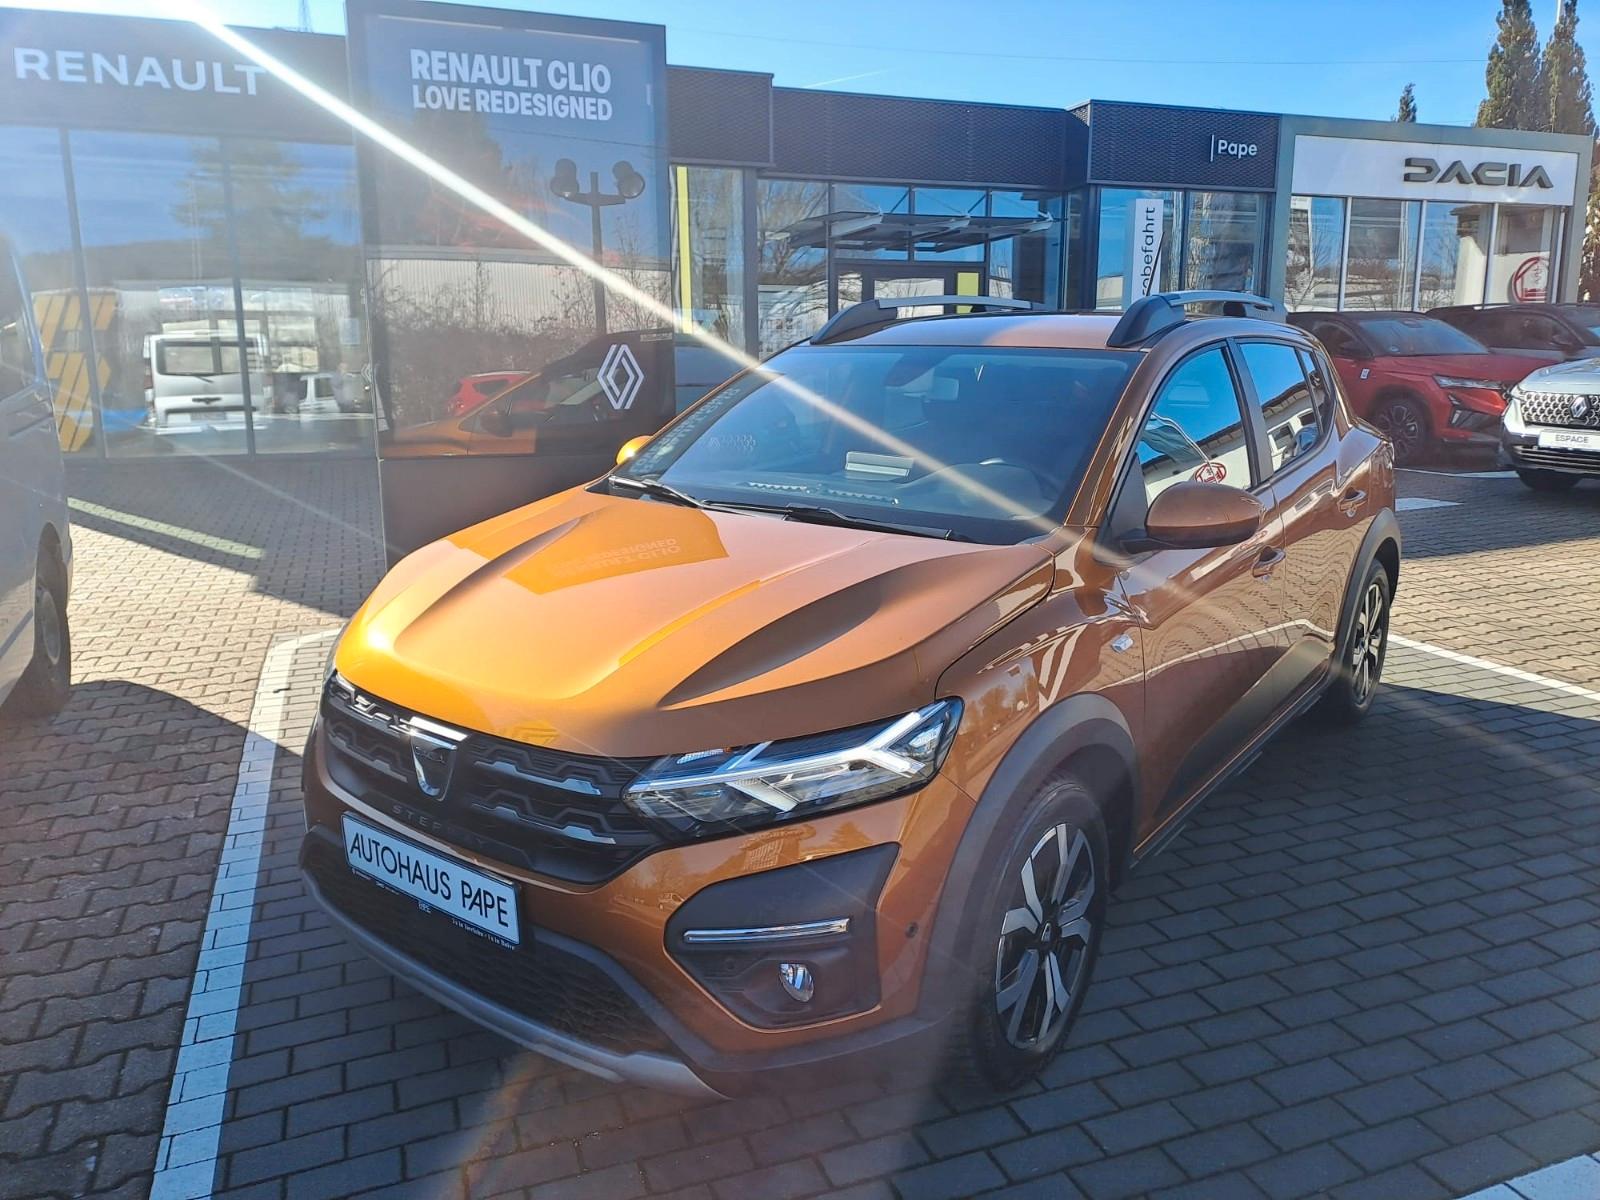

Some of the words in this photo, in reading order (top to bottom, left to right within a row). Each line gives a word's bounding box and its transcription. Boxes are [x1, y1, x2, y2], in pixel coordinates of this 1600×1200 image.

[13, 47, 267, 96] RENAULT
[410, 48, 542, 89] RENAULT
[547, 59, 611, 94] CLIO
[412, 84, 471, 112] LOVE
[475, 88, 613, 121] REDESIGNED
[1217, 139, 1258, 159] Pape
[1403, 157, 1554, 189] DACIA
[1555, 434, 1590, 444] ESPACE
[350, 832, 452, 901] AUTOHAUS
[461, 880, 509, 927] PAPE
